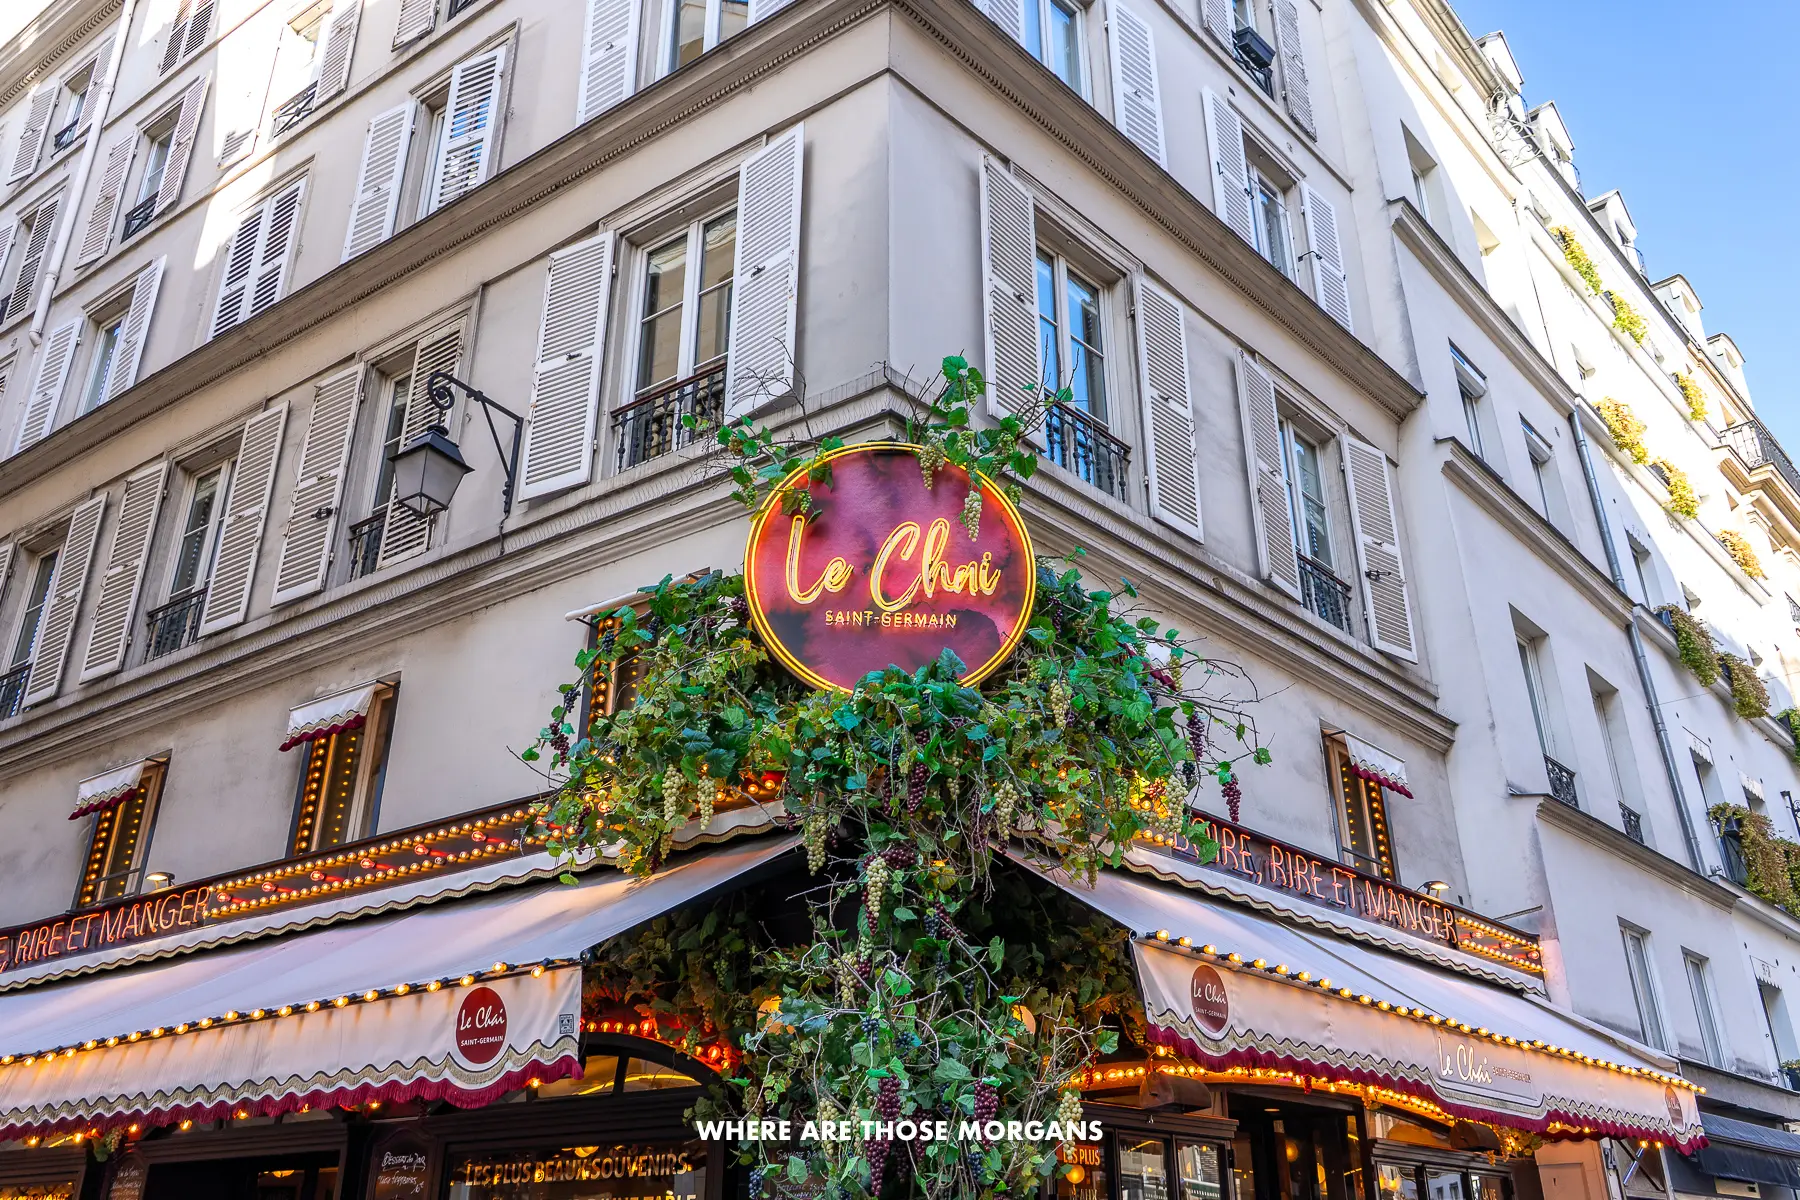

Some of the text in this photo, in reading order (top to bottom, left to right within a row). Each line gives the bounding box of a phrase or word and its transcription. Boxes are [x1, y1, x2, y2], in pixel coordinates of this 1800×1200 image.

[786, 515, 1001, 612] Le Chai
[825, 610, 957, 629] SAINT-GERMAIN
[1270, 844, 1325, 899] RIRE
[1331, 867, 1356, 909] ET
[1364, 880, 1458, 943] MANGER
[15, 921, 66, 964] RIRE
[66, 913, 100, 951] ET
[99, 886, 211, 943] MANGER
[1193, 978, 1227, 1004] Le Chai
[460, 1005, 505, 1031] Le Chai
[1195, 1006, 1227, 1020] SAINT-GERMAIN
[460, 1035, 504, 1047] SAINT-GERMAIN
[1438, 1036, 1454, 1076] Le
[1456, 1043, 1492, 1084] Chai
[465, 1152, 689, 1186] LES PLUS BEAUX SOUVENIRS
[1080, 1148, 1100, 1166] PLUS
